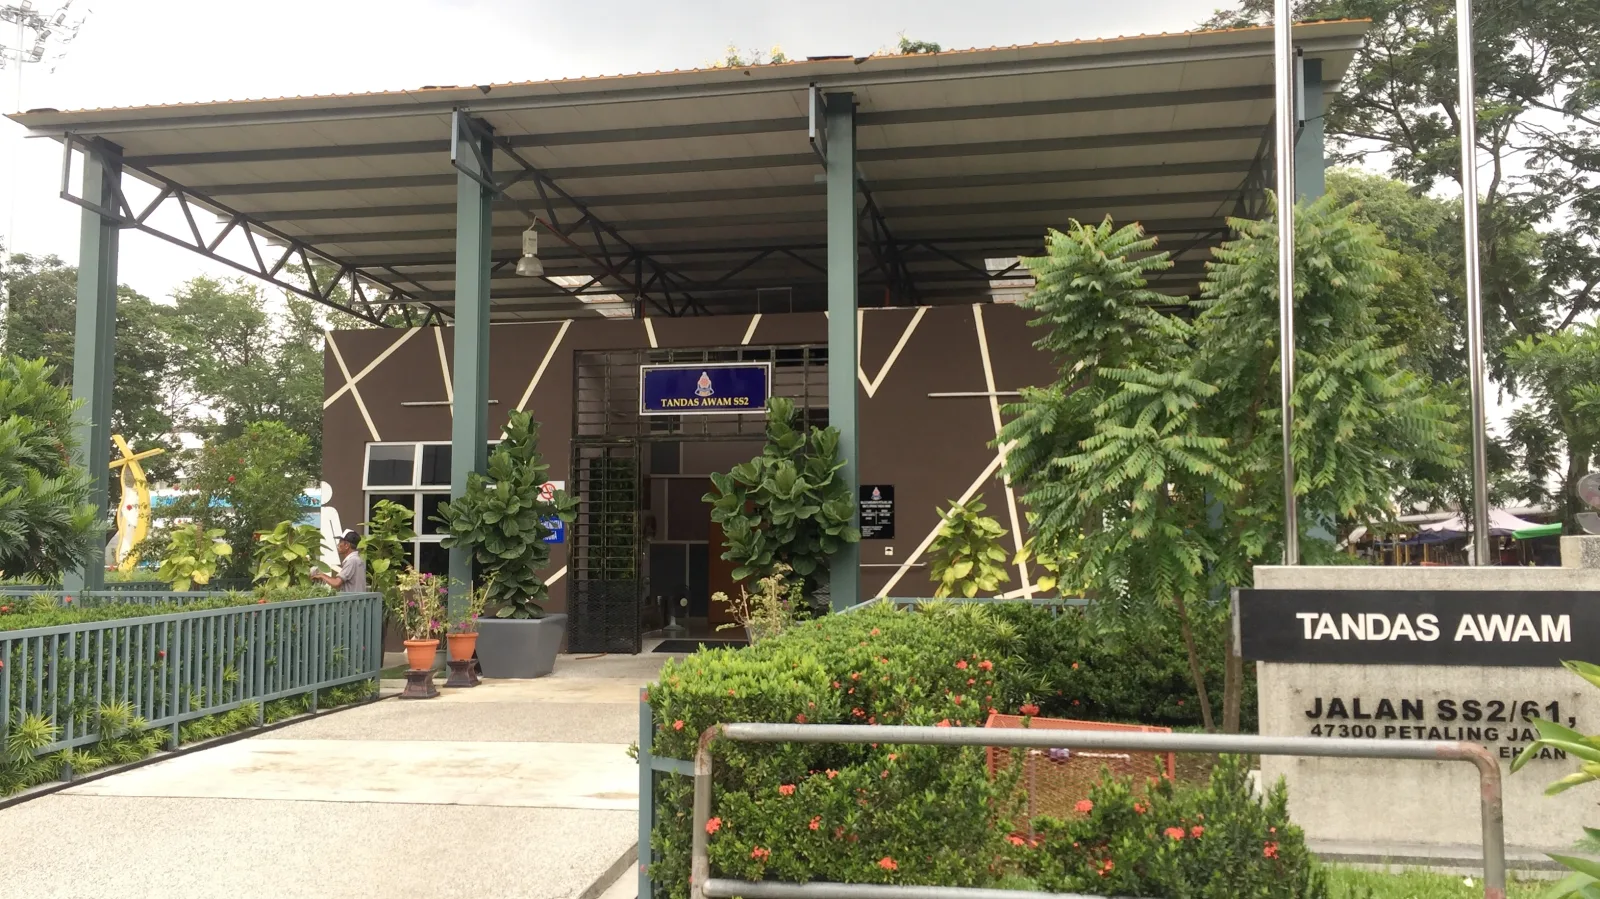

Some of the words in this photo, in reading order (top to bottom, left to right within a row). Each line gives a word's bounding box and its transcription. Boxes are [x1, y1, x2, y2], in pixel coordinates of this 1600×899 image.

[661, 398, 699, 407] TANDAS
[701, 397, 732, 406] AWAM
[733, 397, 749, 406] SS2
[1295, 612, 1441, 642] TANDAS
[1453, 613, 1572, 643] AWAM
[1305, 697, 1424, 720] JALAN
[1437, 699, 1576, 729] SS2/61,
[1310, 723, 1377, 739] 47300
[1383, 725, 1500, 742] PETALING
[1506, 727, 1555, 742] JA
[1499, 746, 1567, 760] EHAN
